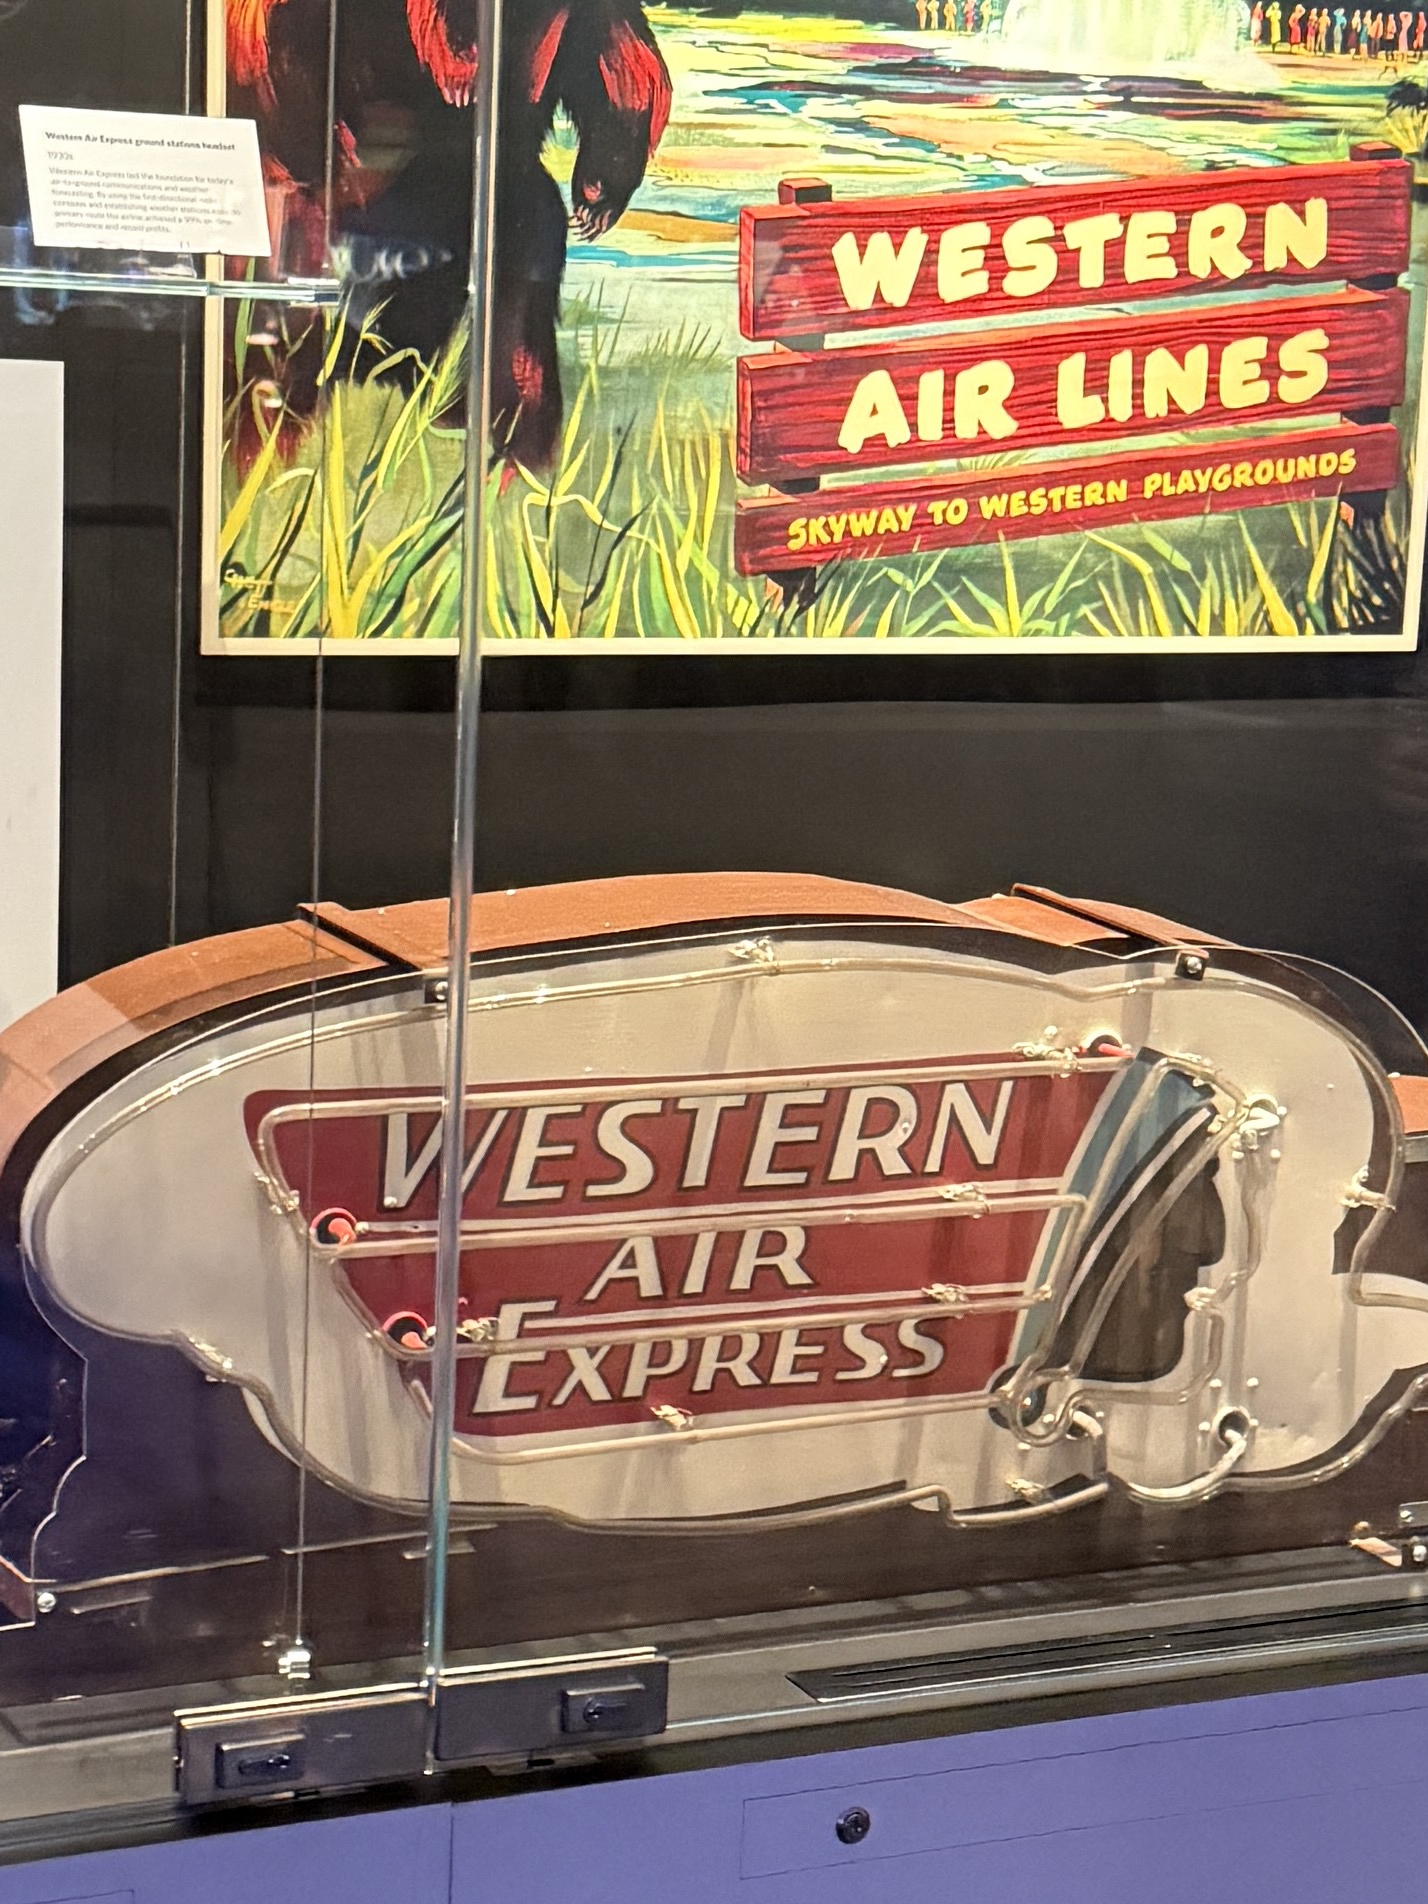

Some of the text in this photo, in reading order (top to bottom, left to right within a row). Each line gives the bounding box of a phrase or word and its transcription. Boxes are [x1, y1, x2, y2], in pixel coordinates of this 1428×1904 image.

[830, 196, 1330, 311] WESTERN
[838, 327, 1331, 455] AIR LINES
[786, 447, 1358, 551] SKYWAY TO WESTERN PLAYGROUNDS
[380, 1079, 1016, 1211] WESTERN
[582, 1226, 816, 1302] AIR
[471, 1299, 947, 1415] EXPRESS
